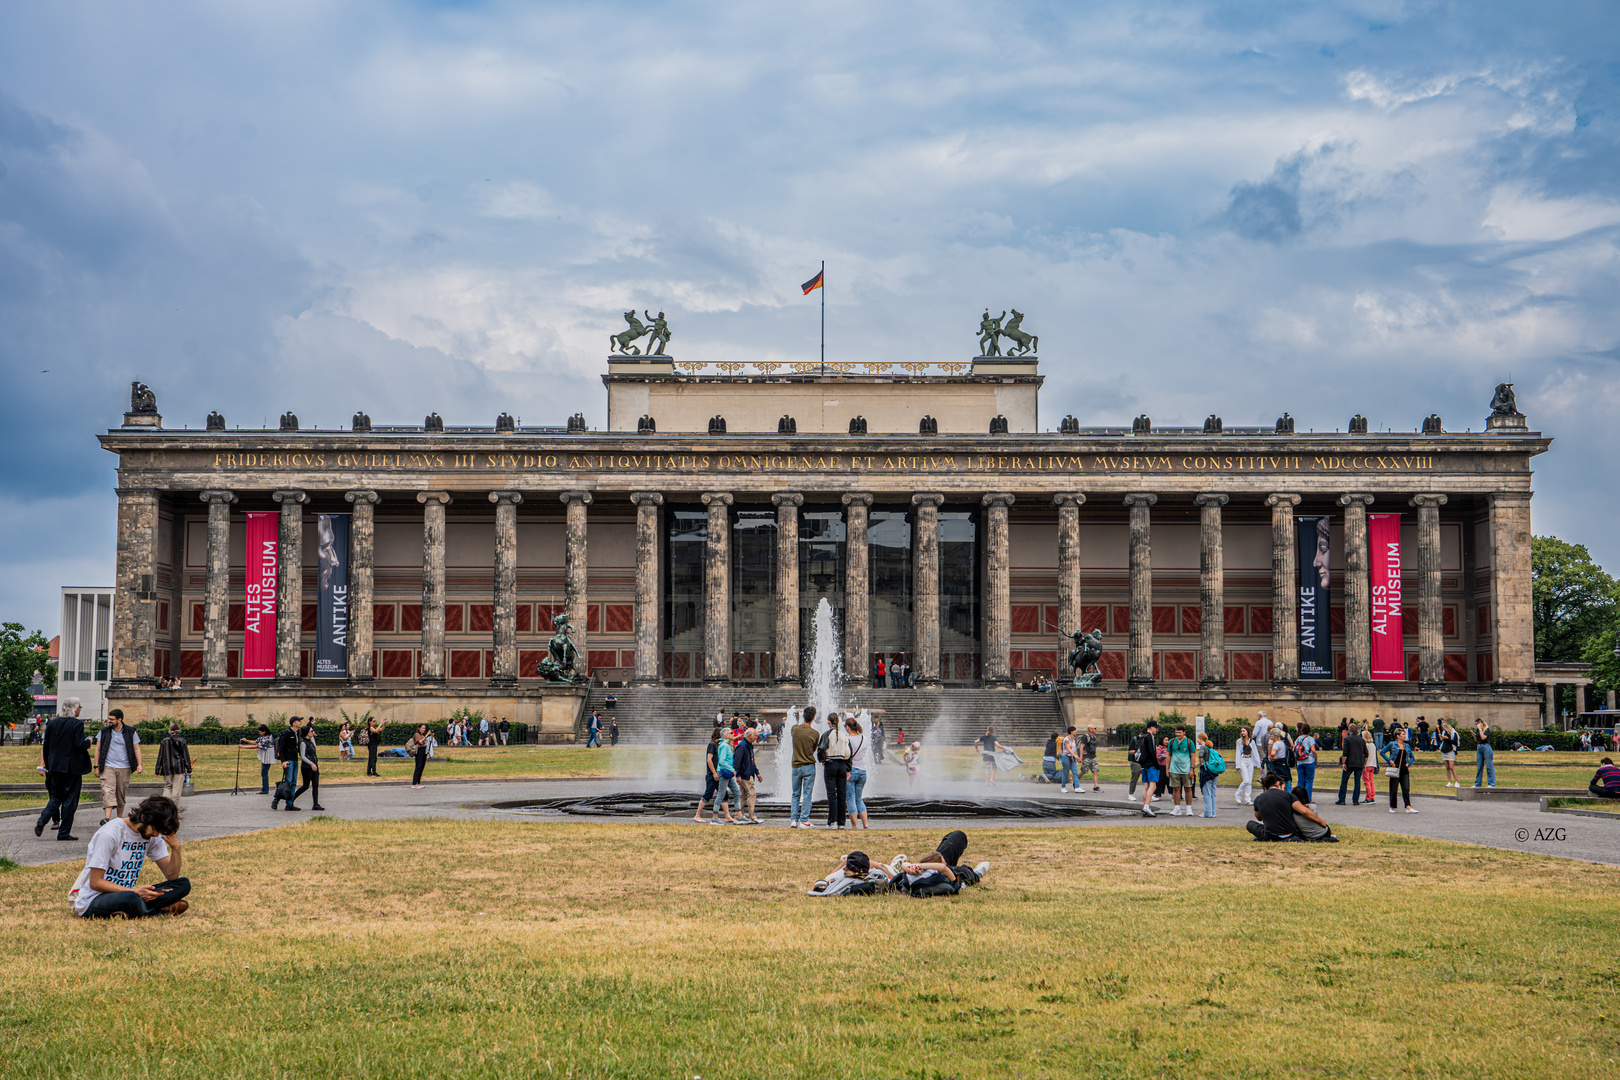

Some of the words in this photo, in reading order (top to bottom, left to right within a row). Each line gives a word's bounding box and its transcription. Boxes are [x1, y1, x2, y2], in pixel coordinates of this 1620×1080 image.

[215, 454, 325, 467] FRIDERICVS
[337, 454, 444, 467] GVILELMVS
[454, 455, 475, 468] III
[486, 454, 557, 468] STVDIO
[568, 455, 710, 469] ANTIQVITATIS
[719, 456, 841, 469] OMNIGENAE
[852, 456, 875, 469] ET
[882, 456, 957, 469] ARTIVM
[967, 456, 1082, 470] LIBERALIVM
[1093, 456, 1173, 470] MVSEVM
[1182, 456, 1302, 470] CONSTITVIT
[1312, 456, 1433, 469] MDCCCXXVIII
[262, 541, 276, 614] MUSEUM
[1387, 542, 1402, 616] MUSEUM
[246, 584, 260, 633] ALTES
[332, 584, 347, 646] ANTIKE
[1300, 586, 1315, 648] ANTIKE
[1372, 585, 1386, 635] ALTES
[121, 841, 148, 851] FIGHT
